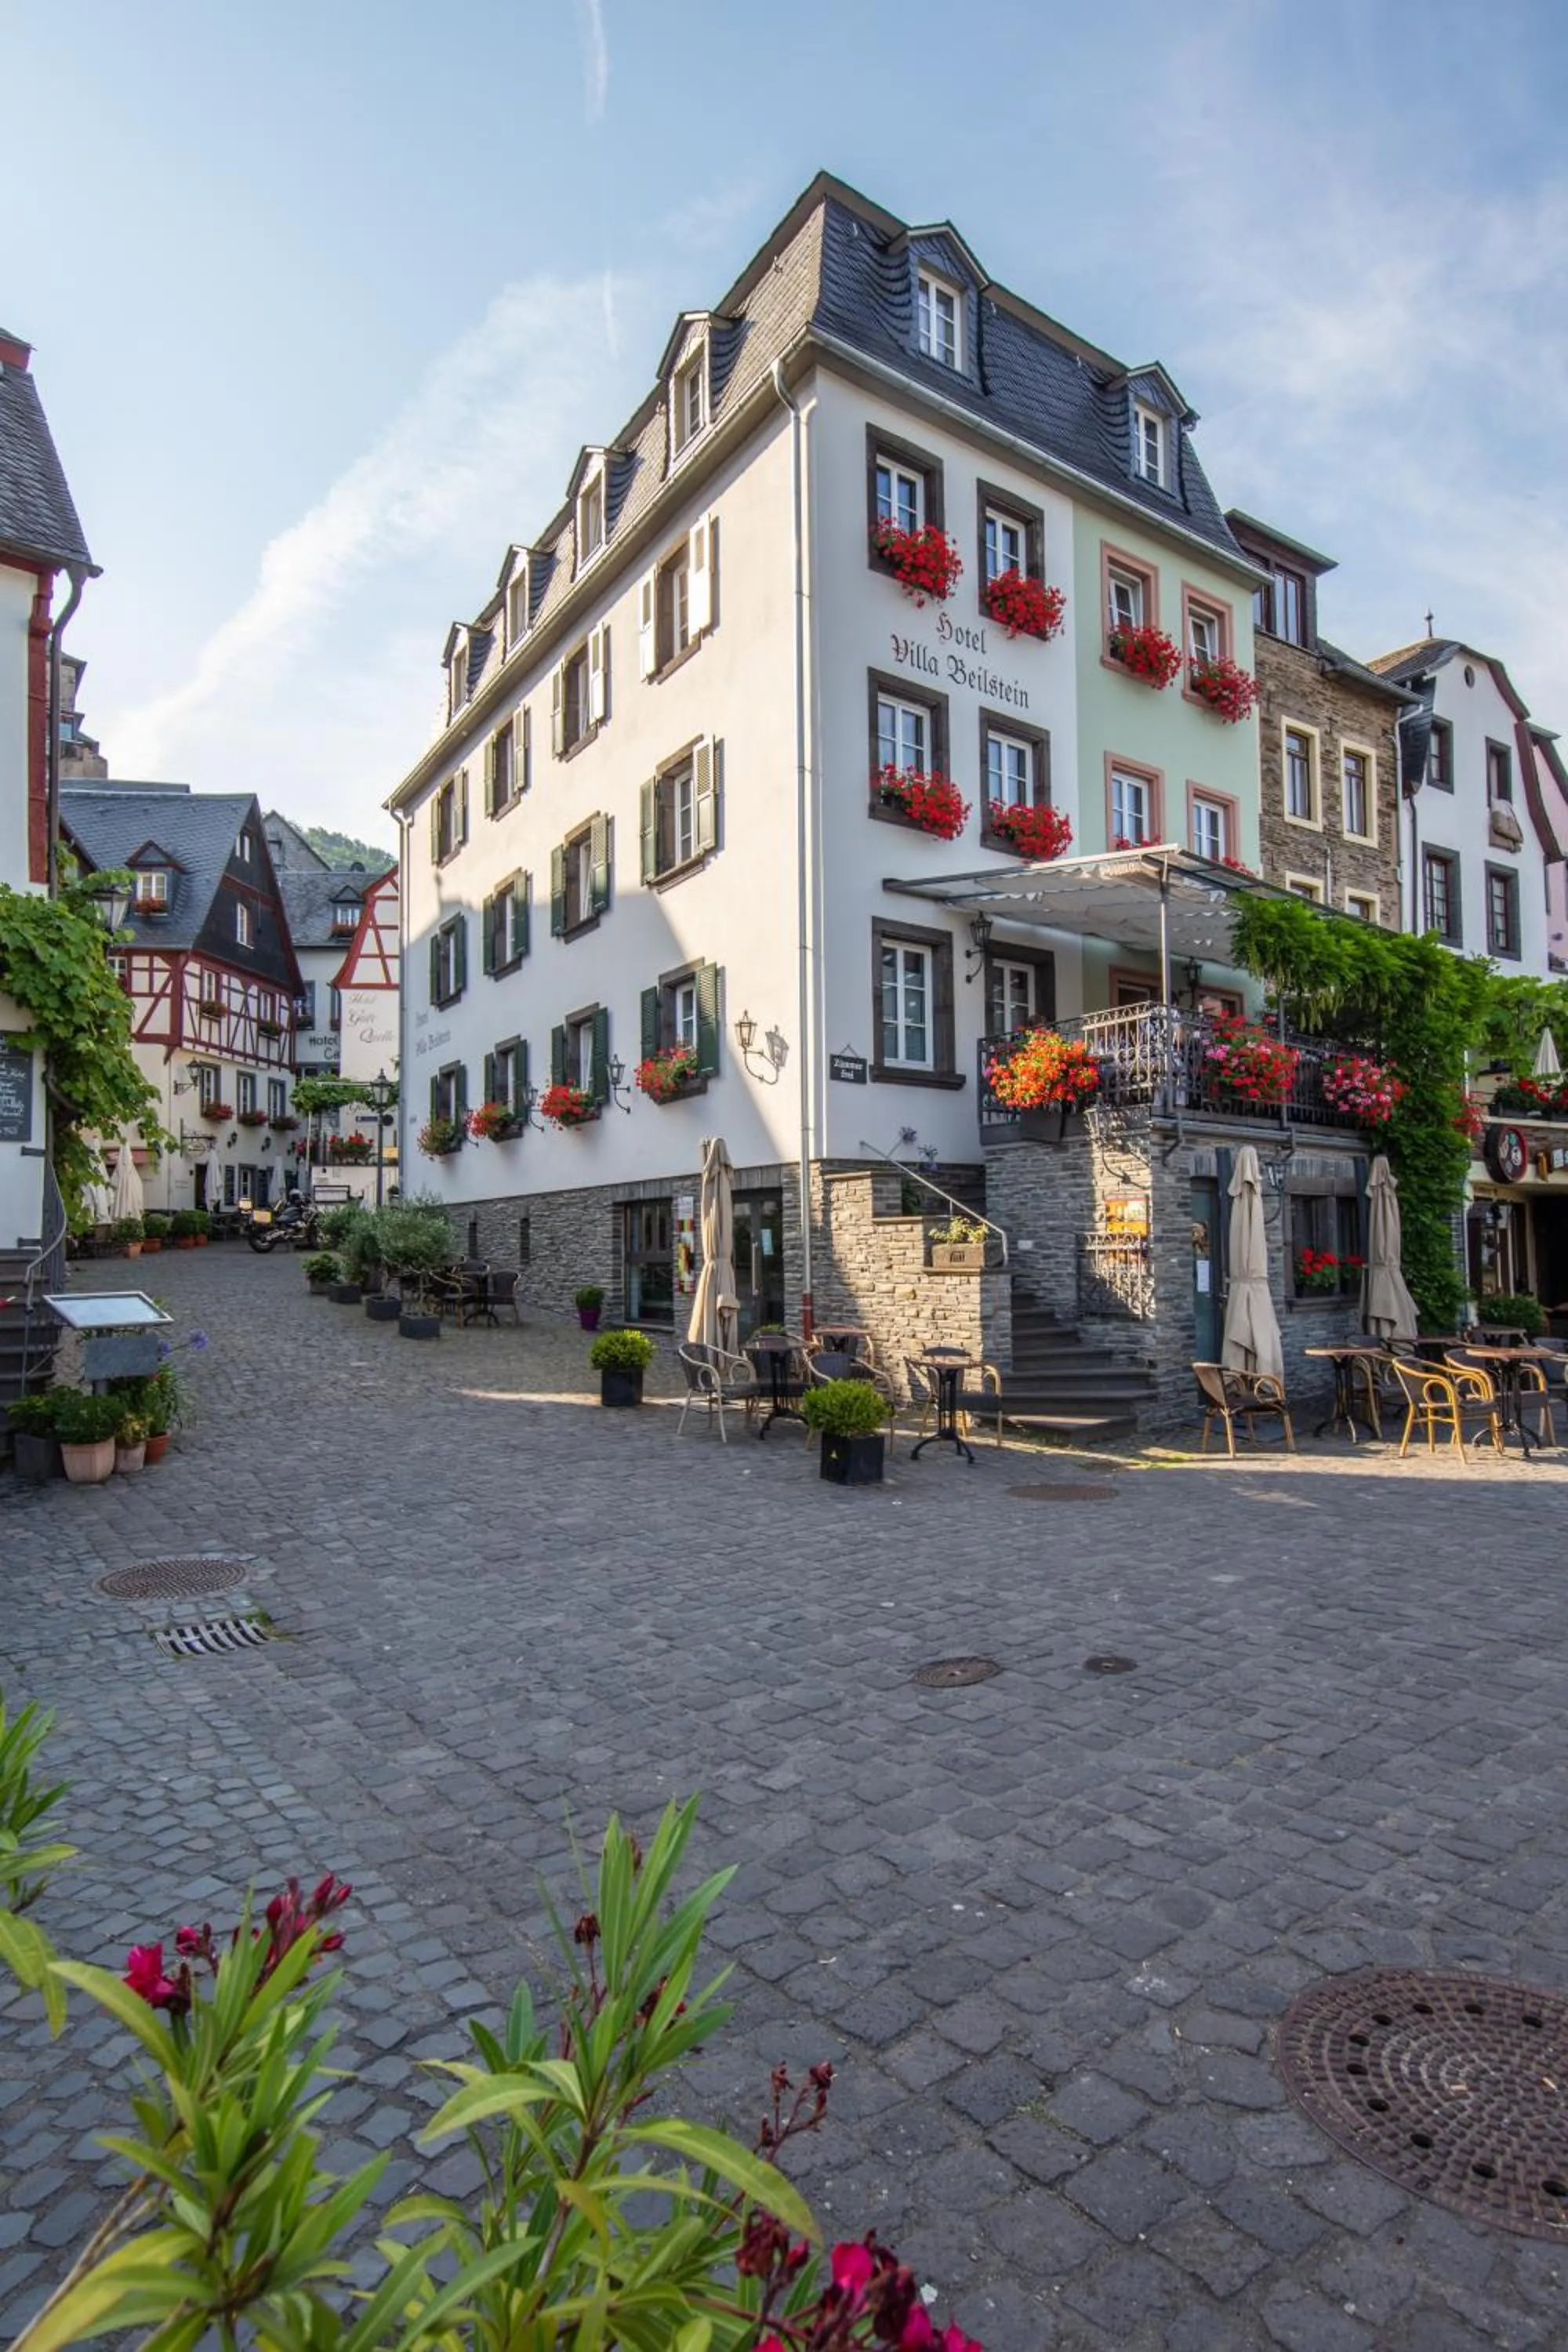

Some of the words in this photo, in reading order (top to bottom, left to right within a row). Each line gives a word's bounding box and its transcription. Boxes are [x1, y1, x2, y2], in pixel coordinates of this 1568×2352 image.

[936, 612, 987, 655] Hotel
[891, 633, 939, 677] Villa
[947, 654, 1029, 709] Beilstein
[309, 1035, 339, 1047] Hotel
